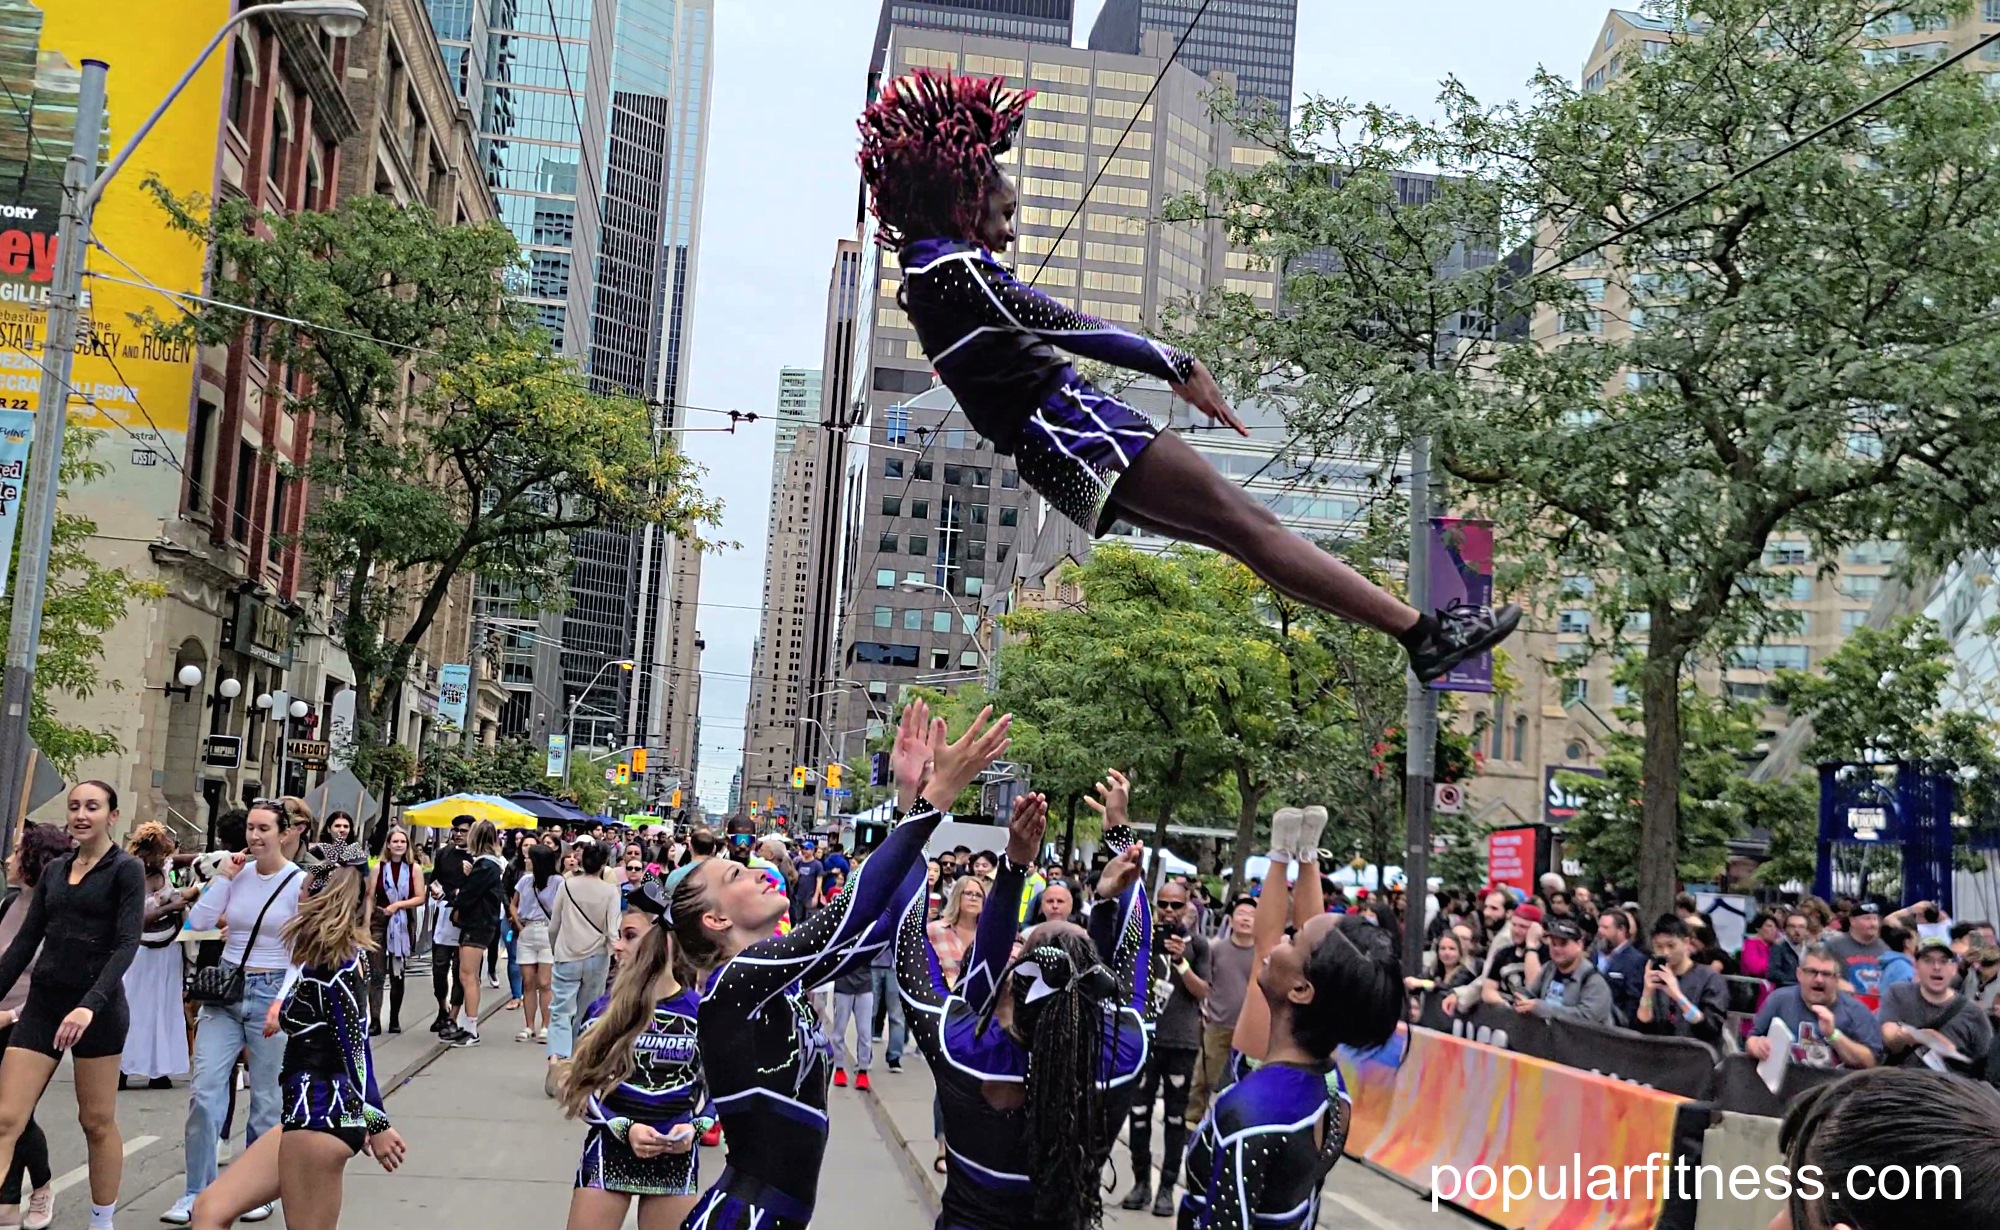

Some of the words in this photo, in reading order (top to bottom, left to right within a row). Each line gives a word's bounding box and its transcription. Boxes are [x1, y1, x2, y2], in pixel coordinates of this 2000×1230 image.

[122, 344, 139, 360] AND
[11, 399, 28, 410] 22
[129, 431, 157, 442] astral
[287, 741, 326, 756] MASCOT
[635, 1036, 695, 1051] HUNDER
